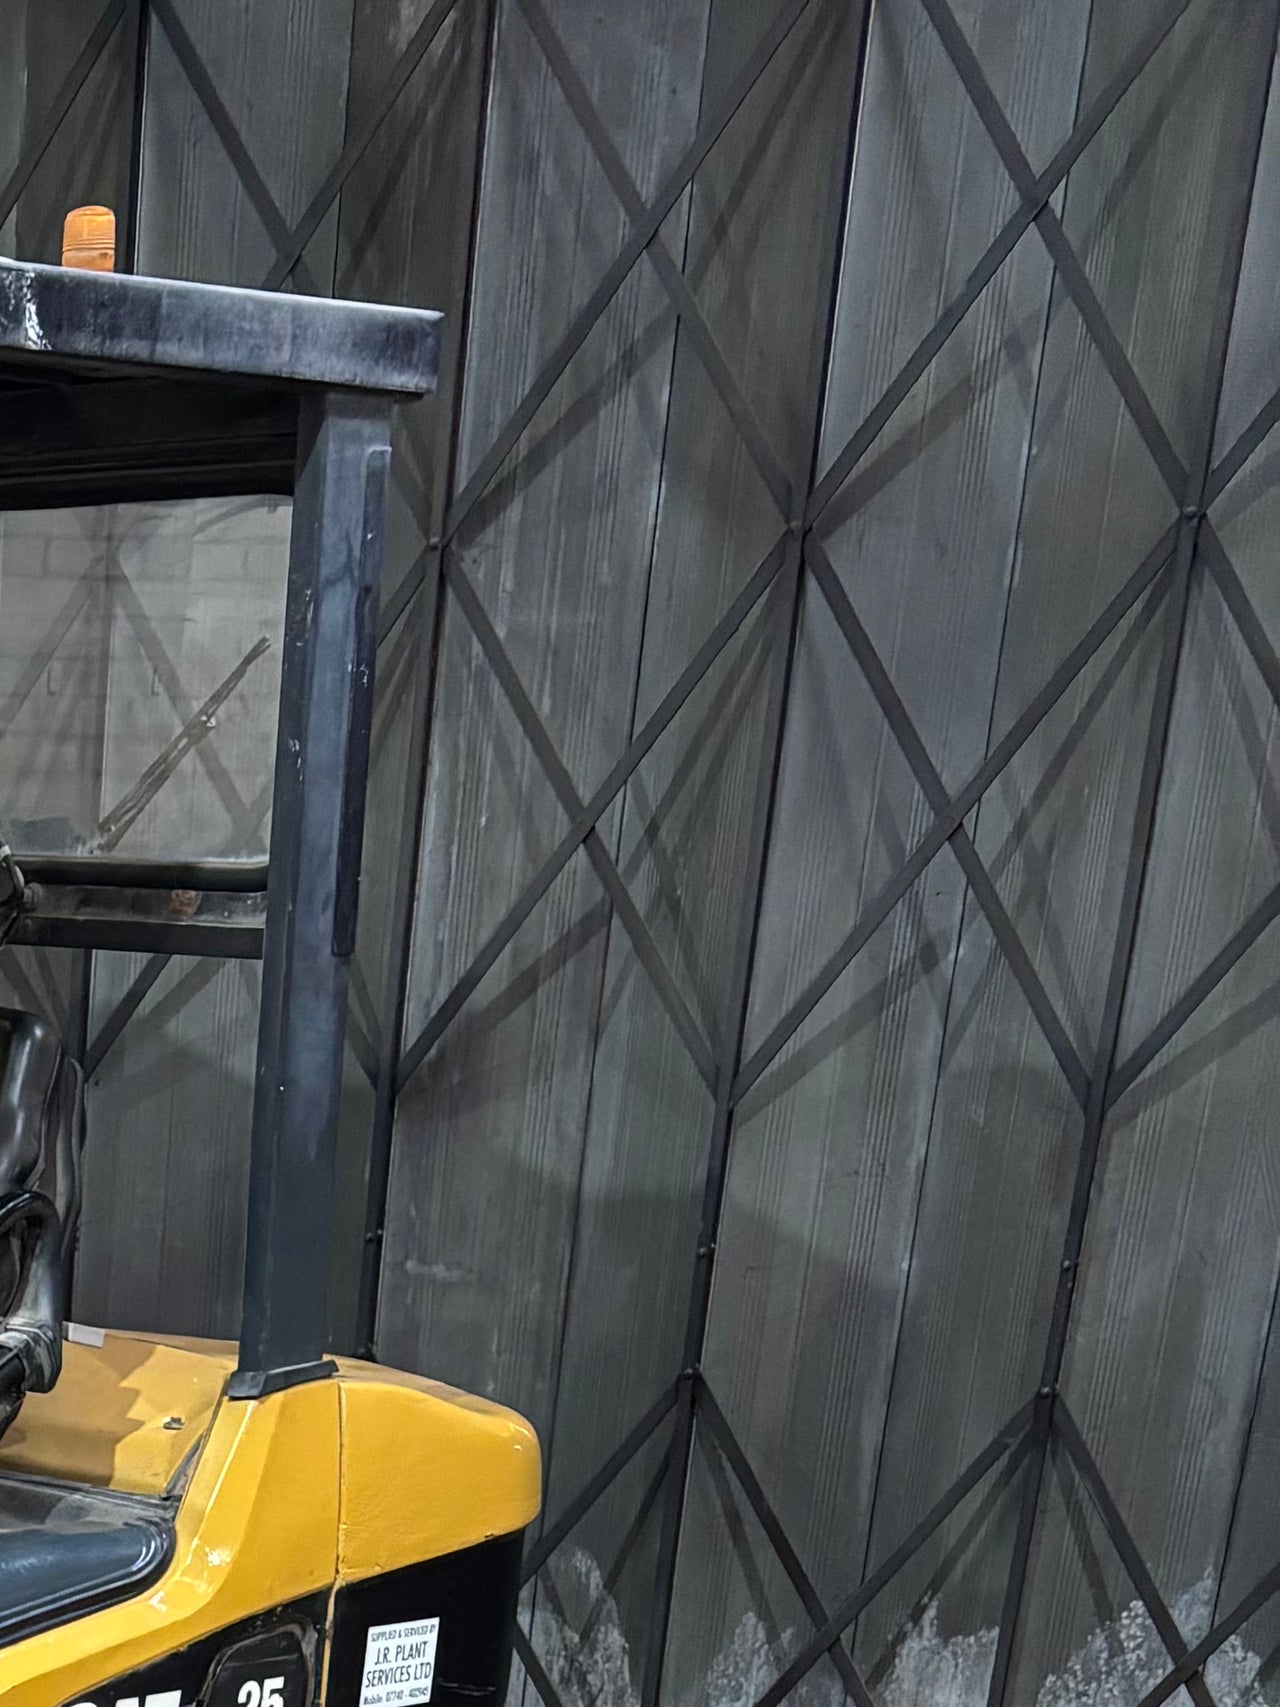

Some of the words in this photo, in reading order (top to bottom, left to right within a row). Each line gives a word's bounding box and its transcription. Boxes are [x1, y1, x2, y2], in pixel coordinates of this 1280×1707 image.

[371, 1628, 398, 1642] SUPPLIED
[403, 1625, 429, 1639] SERVICED
[394, 1641, 428, 1663] PLANT
[365, 1665, 412, 1688] SERVICES
[414, 1662, 432, 1681] LTD
